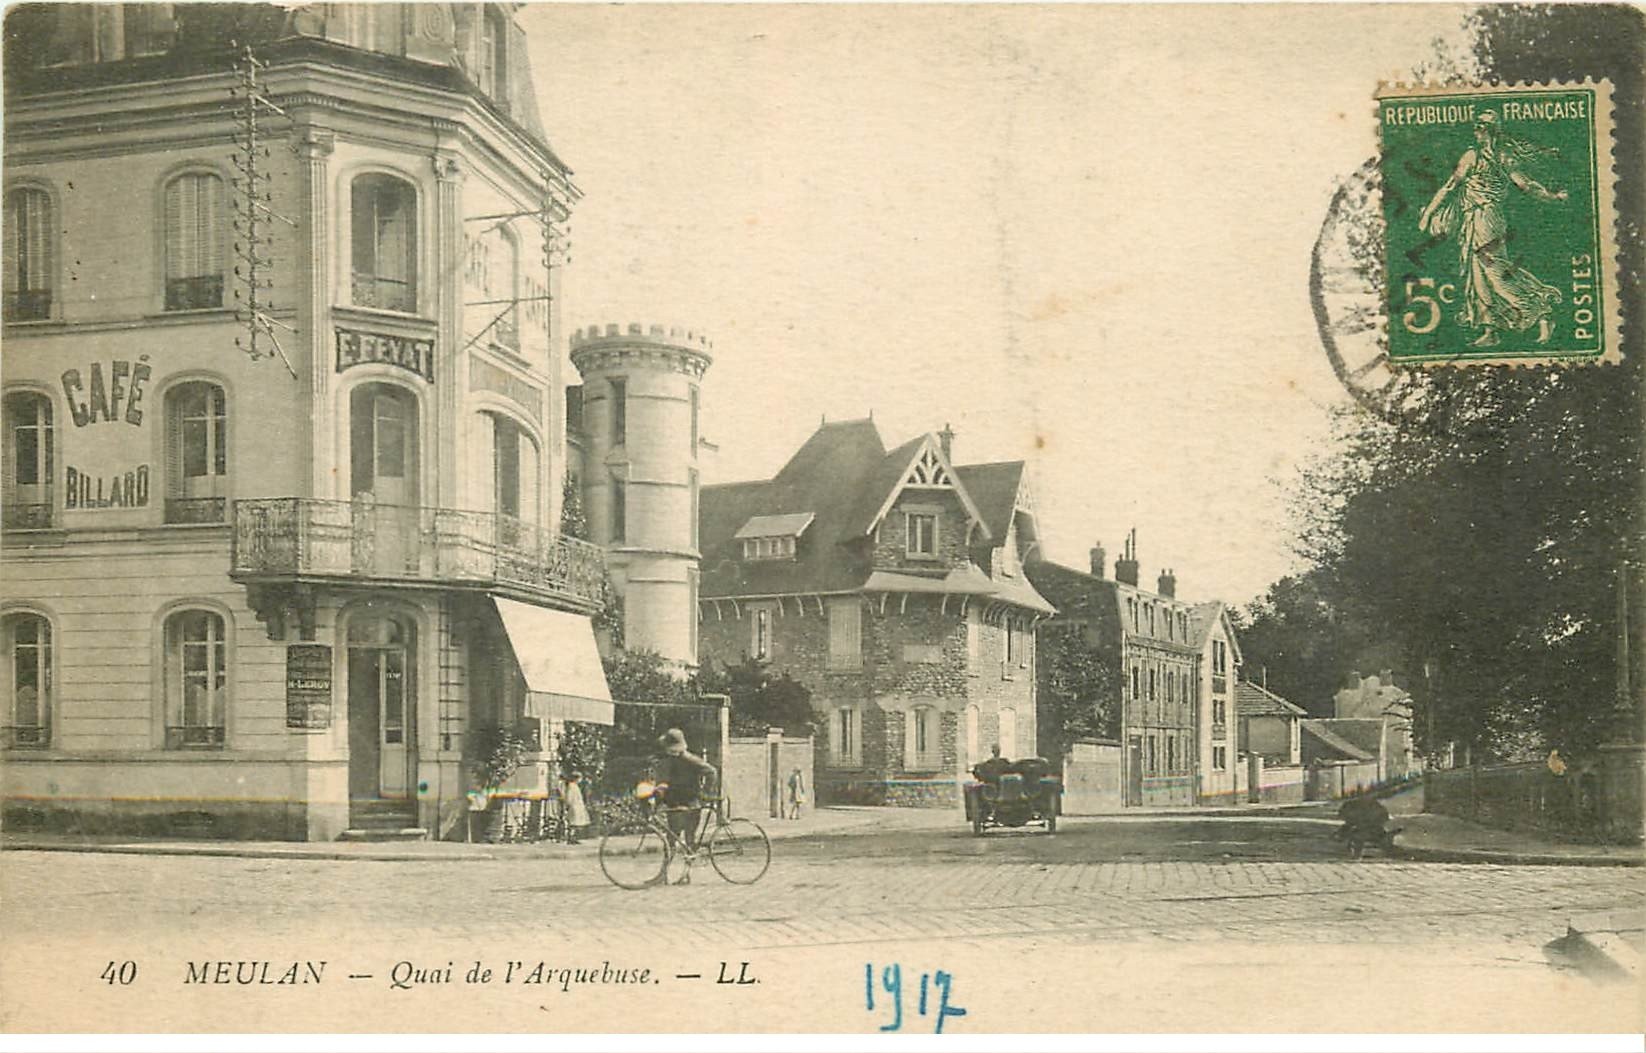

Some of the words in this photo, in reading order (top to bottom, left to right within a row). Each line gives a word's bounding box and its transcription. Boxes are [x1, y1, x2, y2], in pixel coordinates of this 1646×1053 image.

[1503, 101, 1586, 122] FRANÇAISE
[1572, 253, 1594, 340] POSTES
[61, 354, 152, 428] CAFÉ
[65, 464, 149, 509] BILLARD
[865, 963, 967, 1035] 1917
